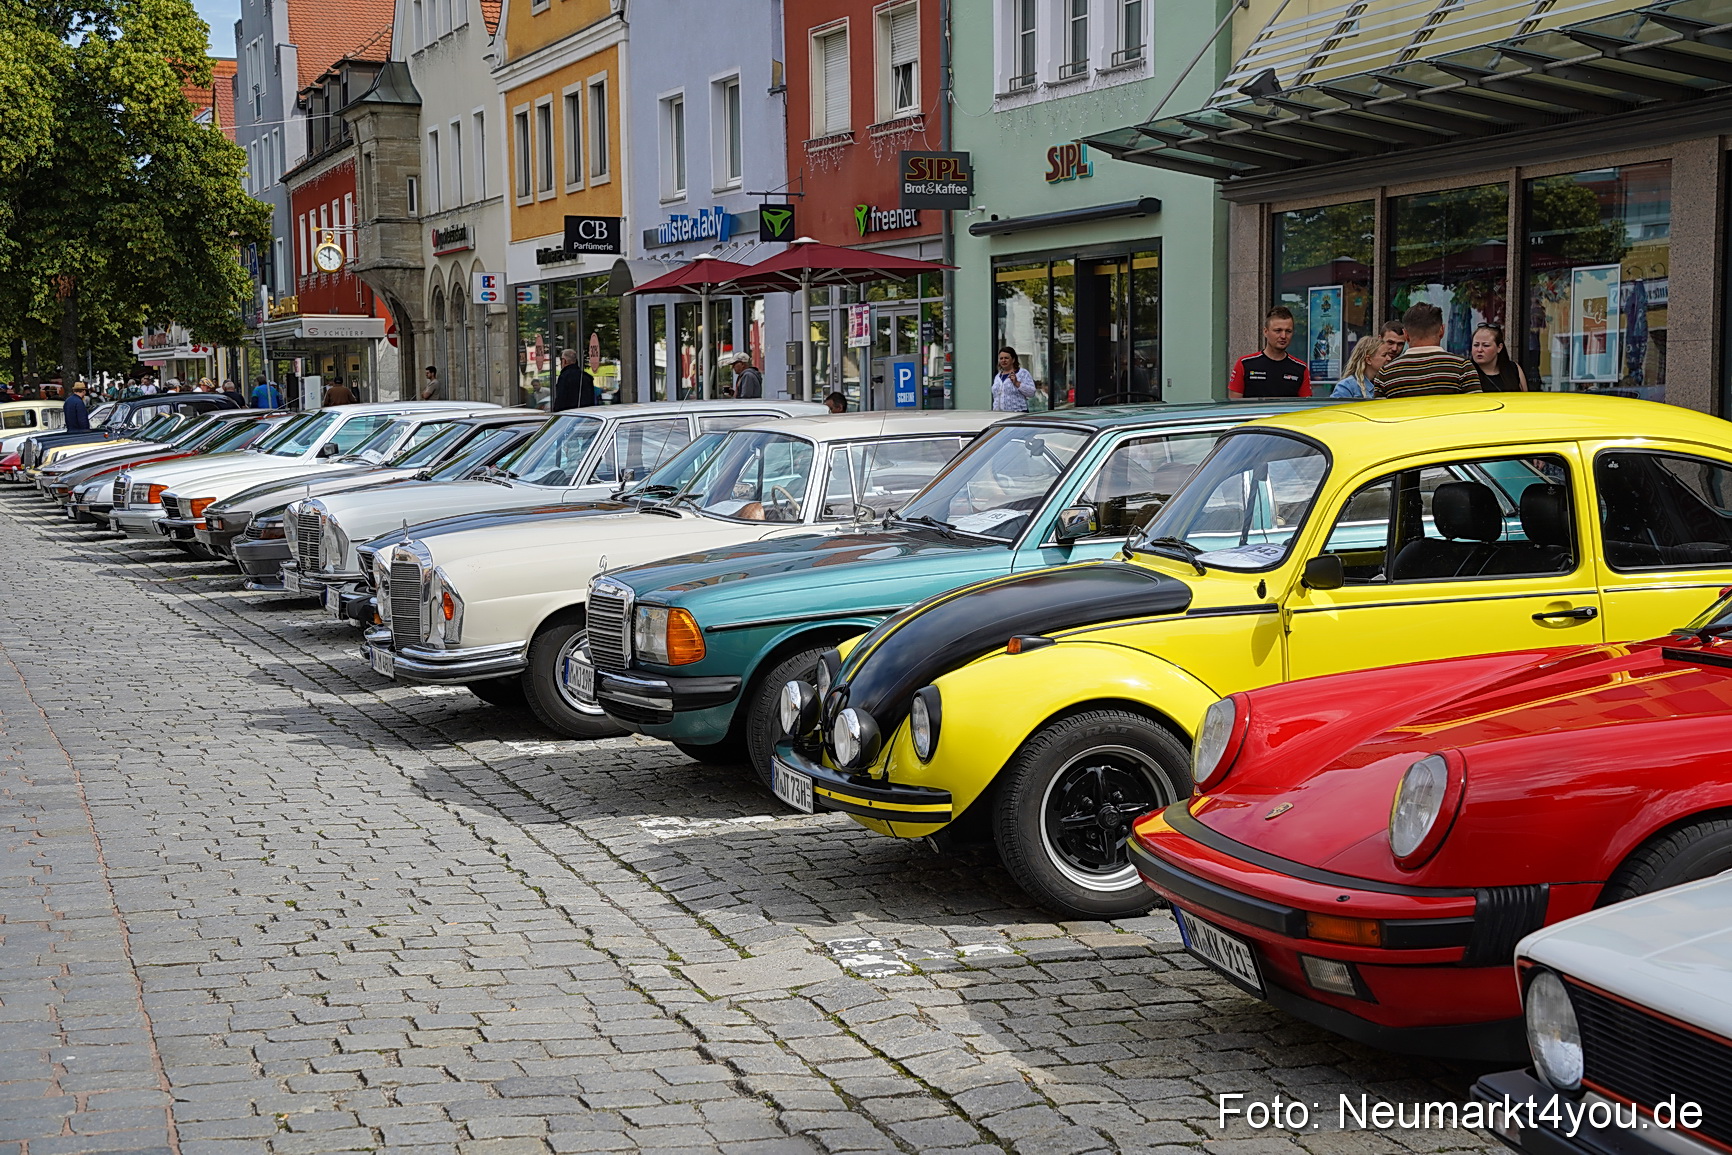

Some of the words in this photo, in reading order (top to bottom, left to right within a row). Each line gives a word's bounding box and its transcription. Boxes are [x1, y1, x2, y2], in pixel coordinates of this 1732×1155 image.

[905, 156, 968, 181] SIPL
[1045, 142, 1089, 182] SIPL
[904, 182, 968, 194] Brot&Kaffee
[578, 219, 608, 239] CB
[658, 213, 694, 244] mister
[697, 206, 724, 242] lady
[870, 205, 918, 232] freenet
[573, 241, 614, 251] Parfümerie
[899, 368, 912, 389] P
[790, 775, 807, 808] 73H
[1202, 925, 1227, 966] KK
[1220, 936, 1252, 981] 911
